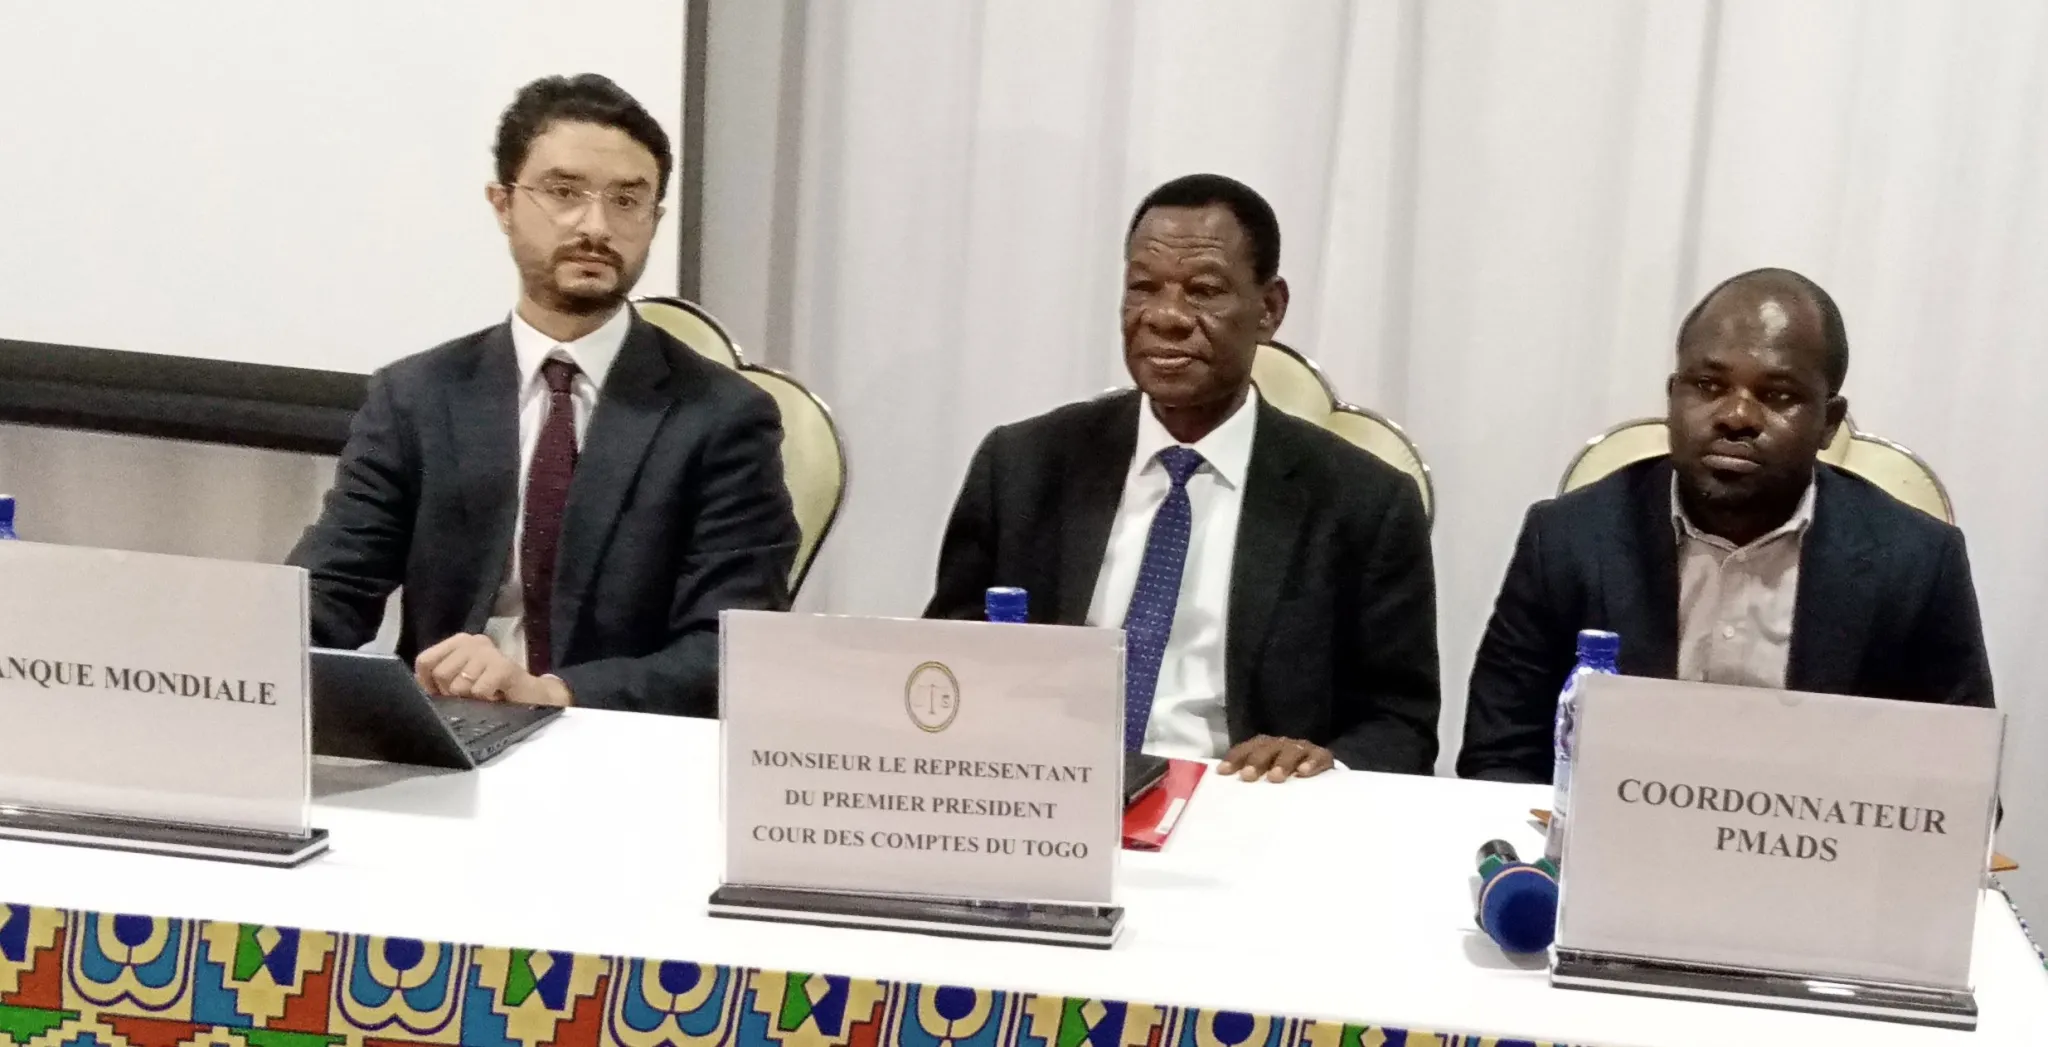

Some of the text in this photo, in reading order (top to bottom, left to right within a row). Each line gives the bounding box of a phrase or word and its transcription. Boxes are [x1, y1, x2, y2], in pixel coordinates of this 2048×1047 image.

[104, 665, 277, 706] MONDIALE
[751, 748, 1093, 784] MONSIEUR LE REPRESENTANT
[784, 788, 1058, 820] DU PREMIER PRESIDENT
[1617, 777, 1948, 836] COORDONNATEUR
[751, 824, 1089, 860] COUR DES COMPTES DU TOGO
[1715, 826, 1838, 863] PMADS
